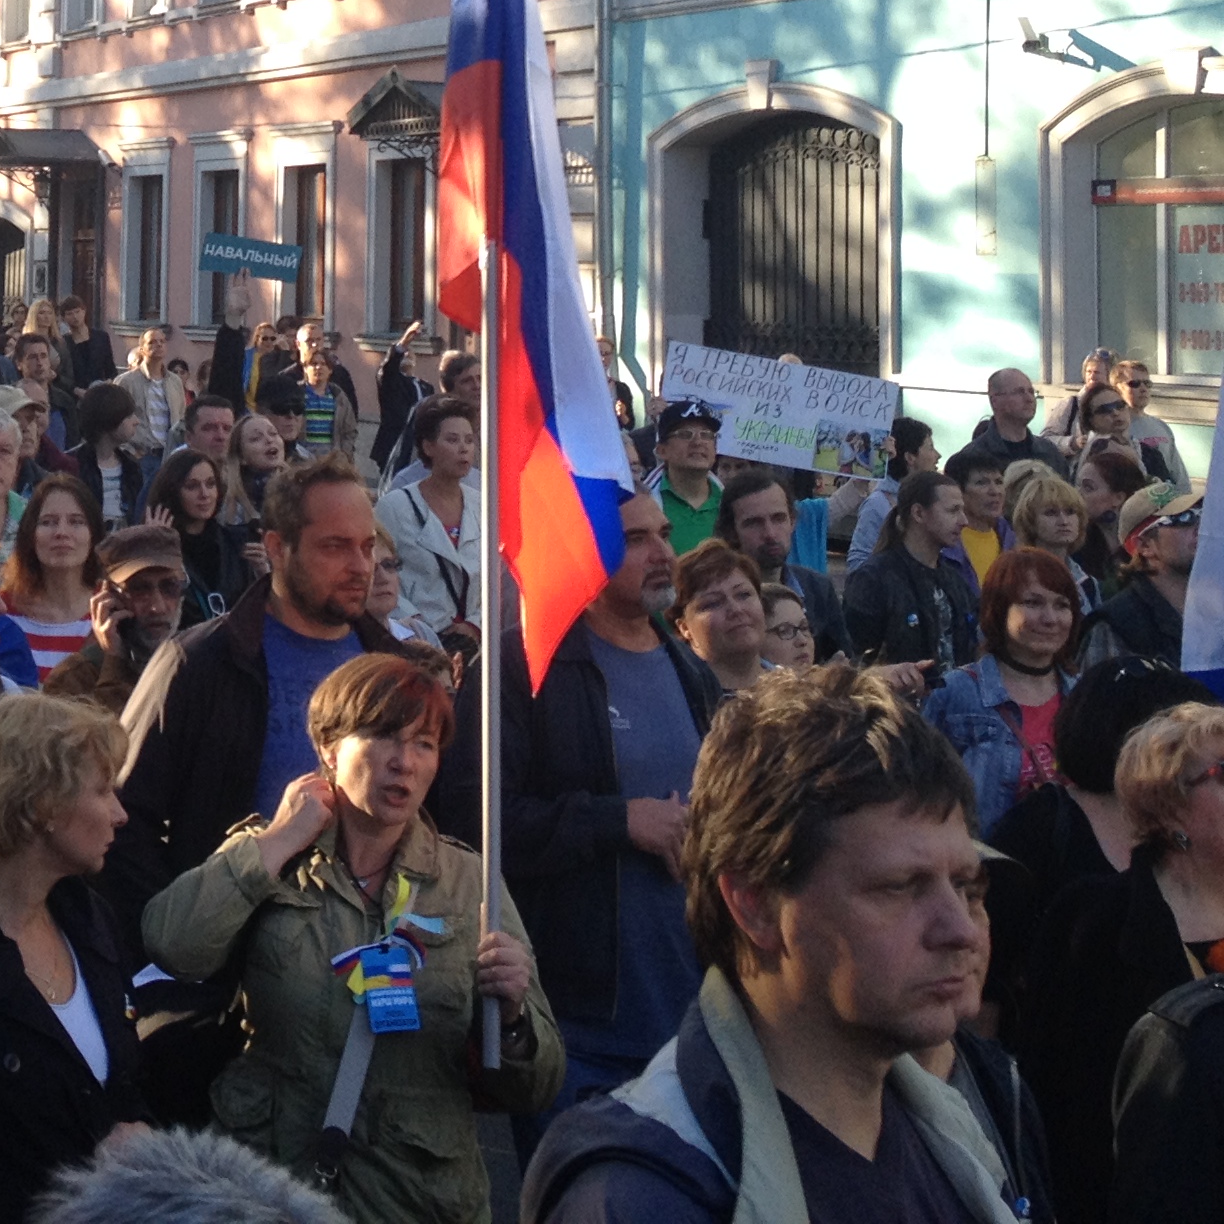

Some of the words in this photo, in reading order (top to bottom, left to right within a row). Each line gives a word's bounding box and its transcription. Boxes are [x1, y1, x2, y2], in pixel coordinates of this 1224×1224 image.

[1178, 224, 1224, 254] АРЕ
[204, 243, 298, 269] НАВАЛЬНЫЙ
[671, 344, 689, 364] Я
[701, 347, 792, 383] ТРЕБУЮ
[803, 367, 889, 401] ВЫВОДА
[753, 401, 783, 419] ИЗ
